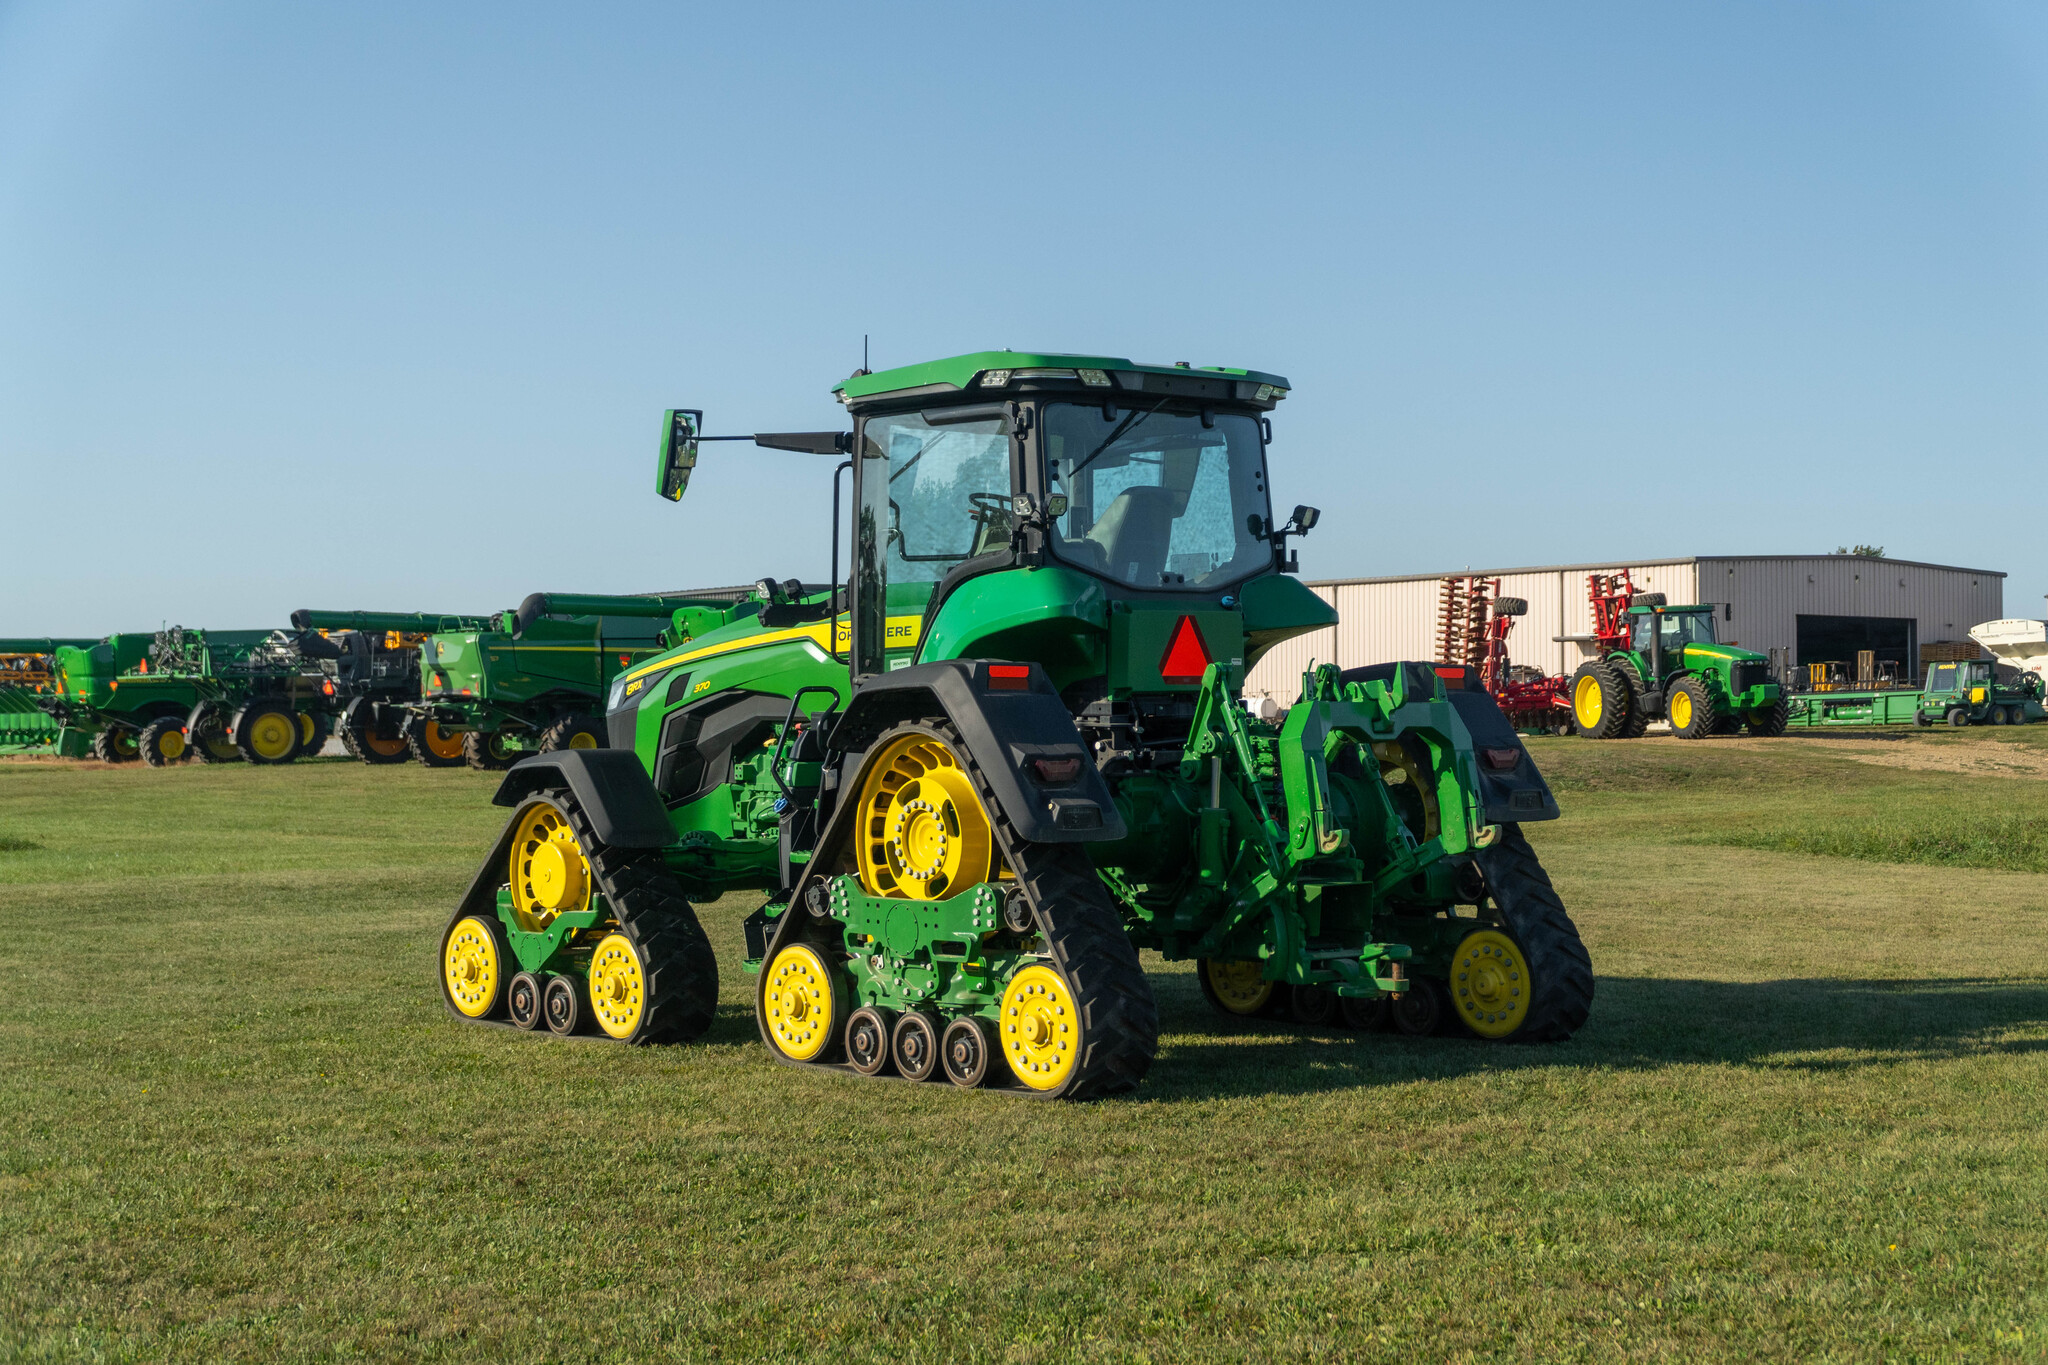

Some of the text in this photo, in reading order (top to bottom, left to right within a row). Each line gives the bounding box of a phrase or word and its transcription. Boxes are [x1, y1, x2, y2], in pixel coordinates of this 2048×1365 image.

[886, 625, 912, 637] ERE
[626, 678, 643, 696] 8RX
[693, 680, 711, 693] 370
